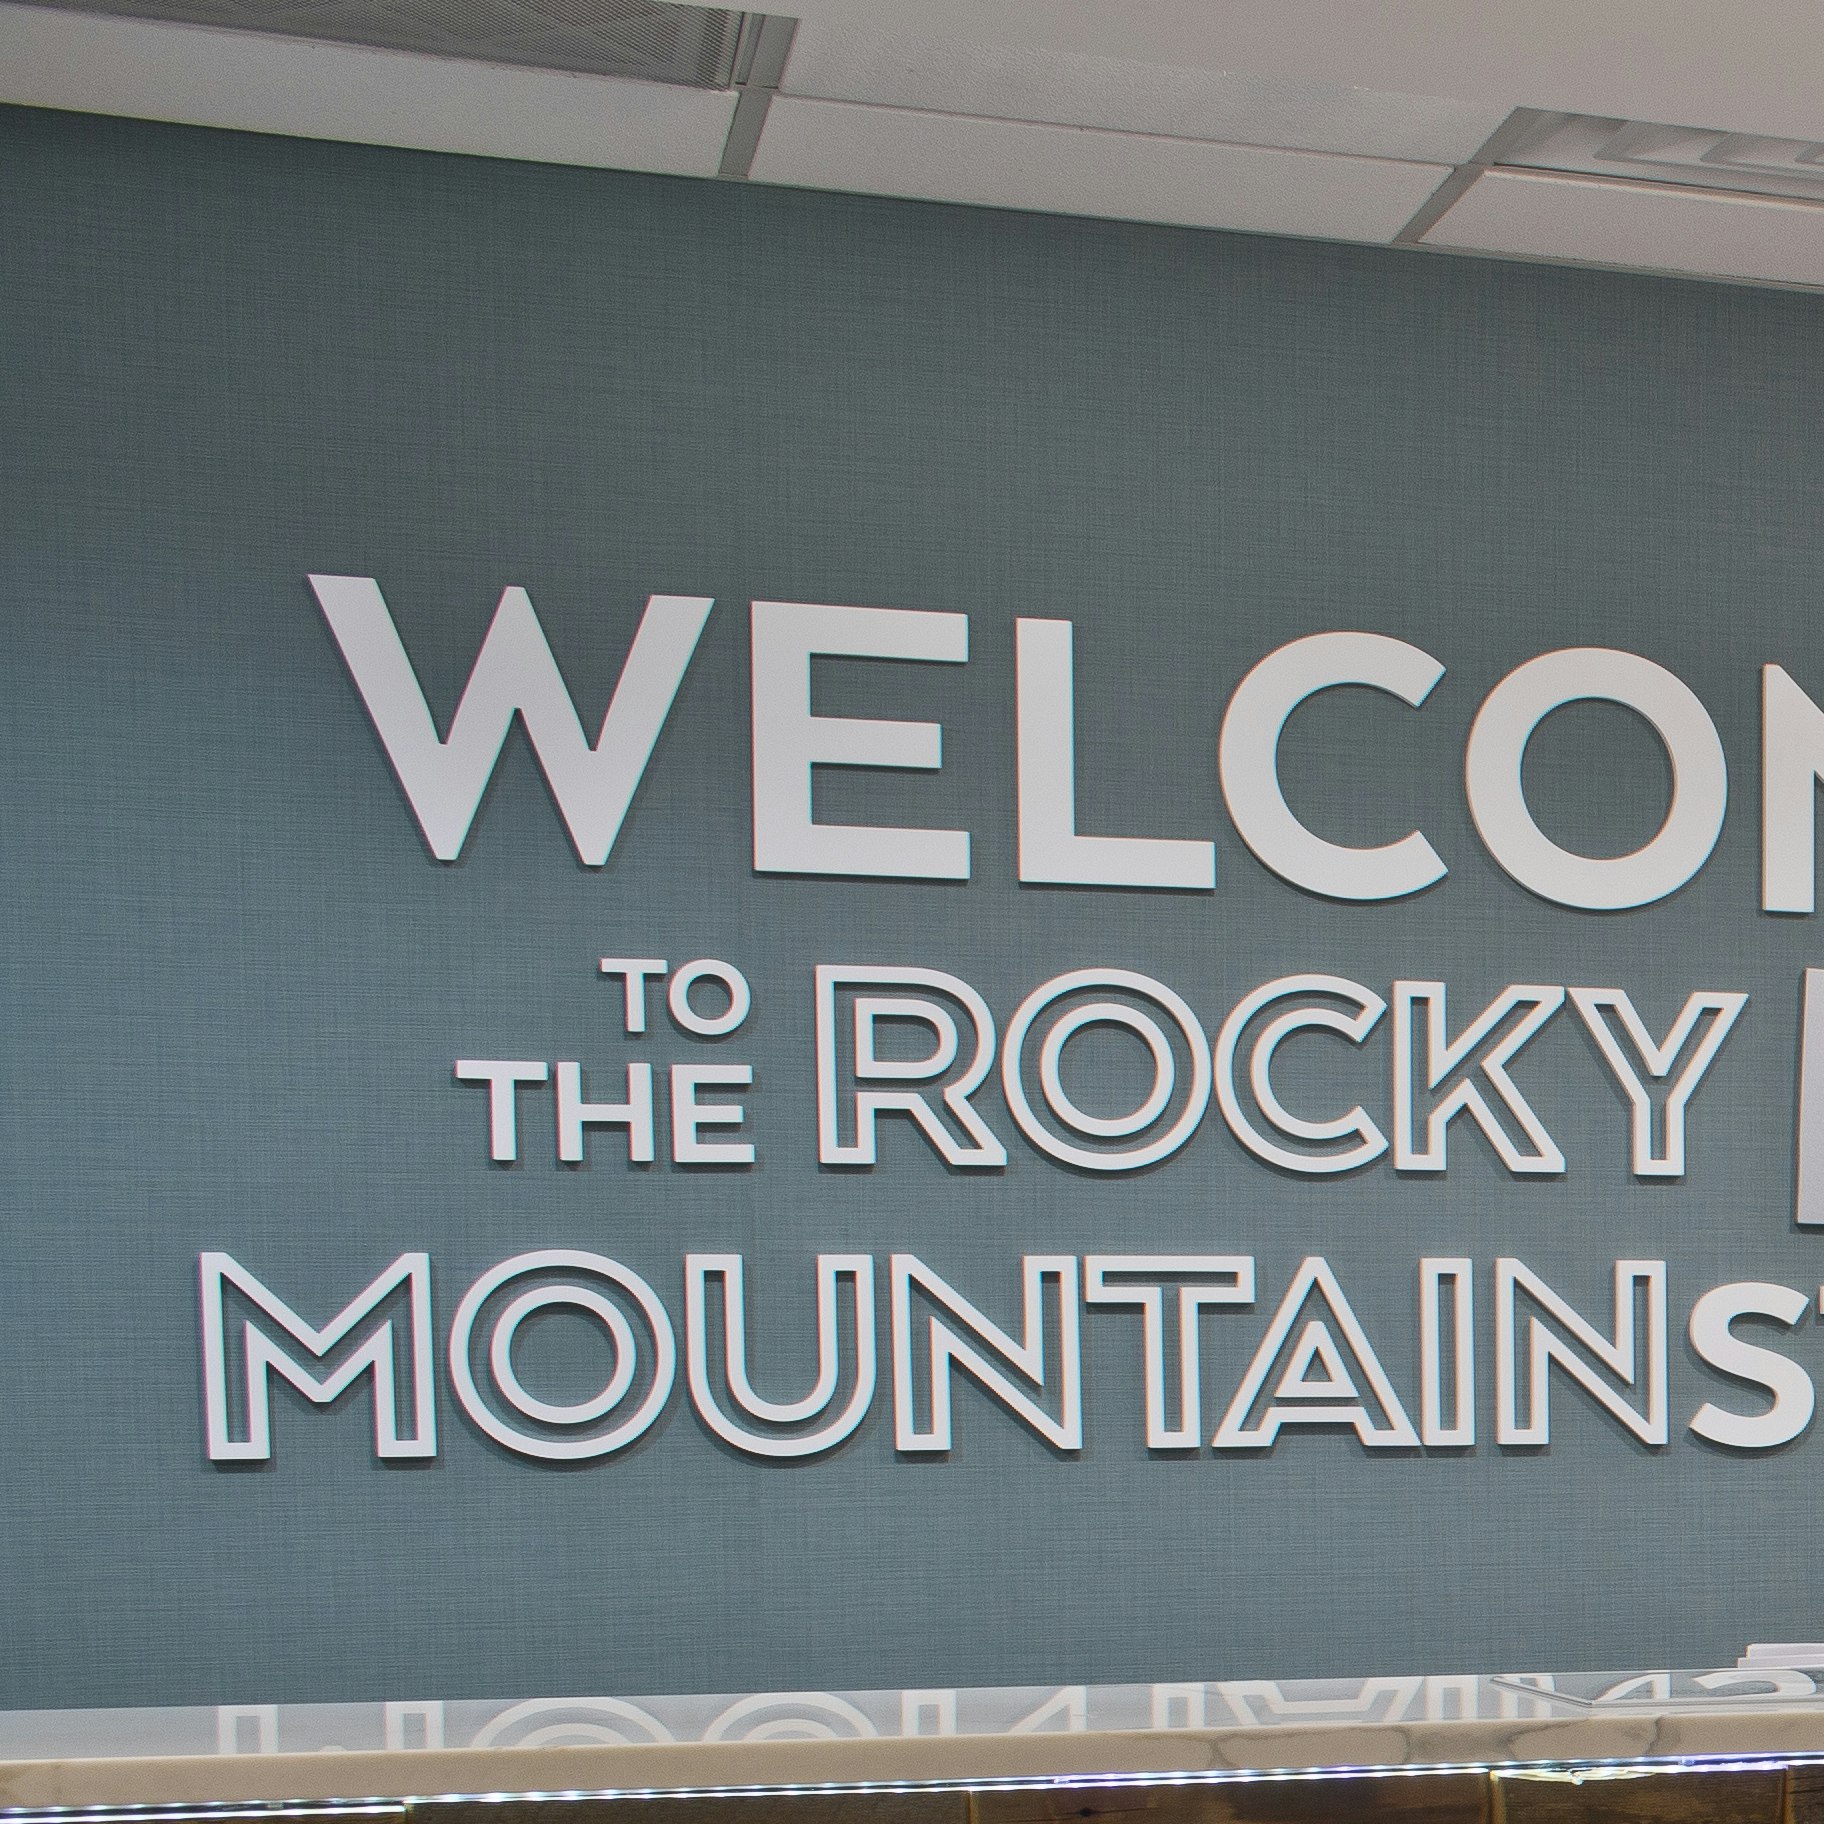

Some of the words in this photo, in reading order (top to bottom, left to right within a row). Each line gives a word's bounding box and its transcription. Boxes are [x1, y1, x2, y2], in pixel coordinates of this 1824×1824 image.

[600, 957, 752, 1036] TO
[455, 1060, 755, 1164] THE
[815, 964, 1749, 1177] ROCKY
